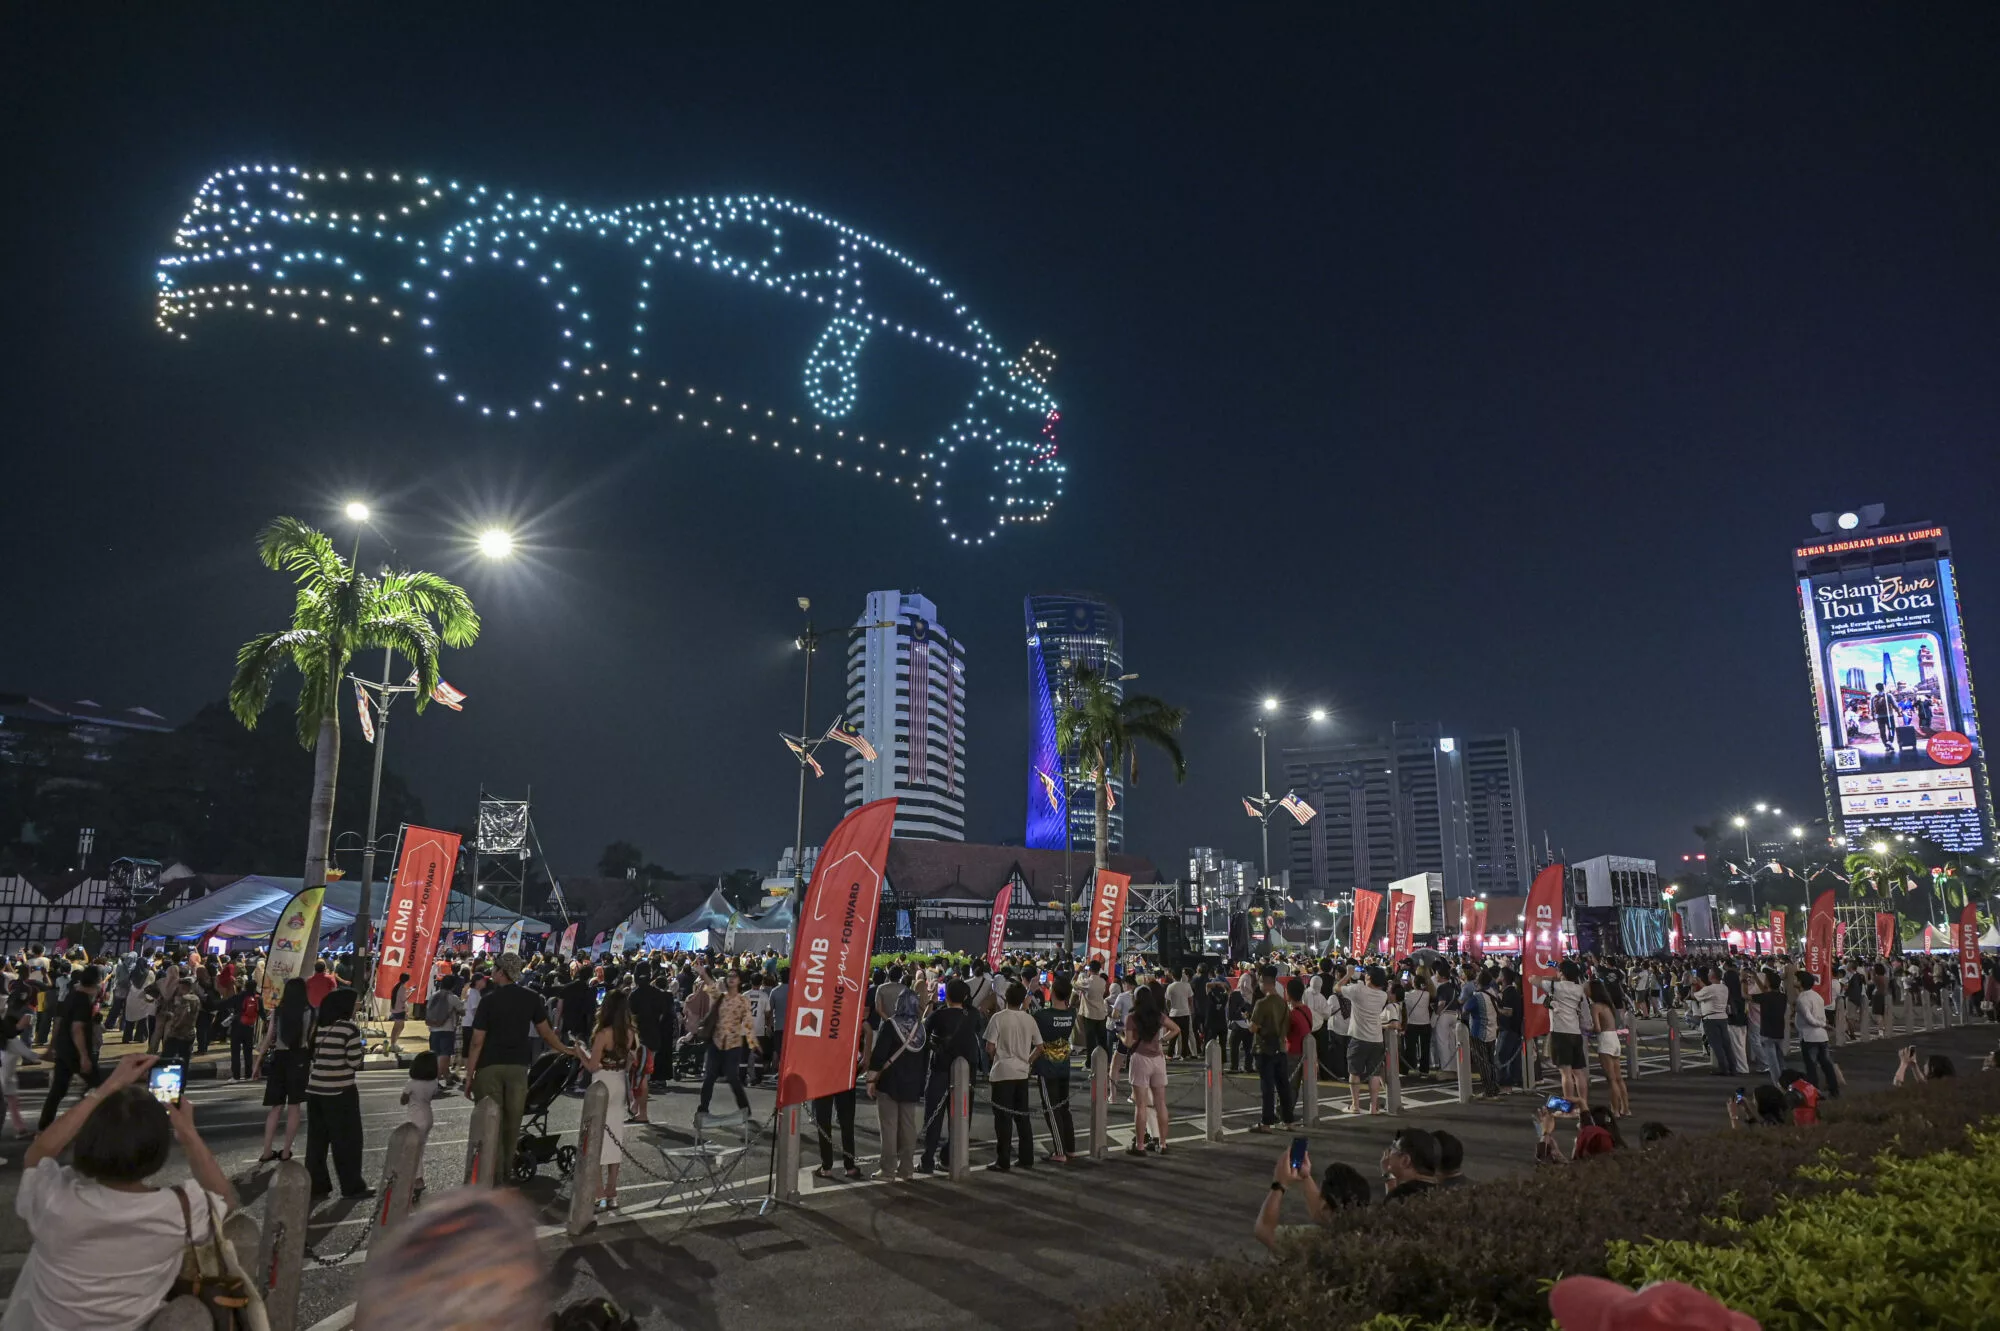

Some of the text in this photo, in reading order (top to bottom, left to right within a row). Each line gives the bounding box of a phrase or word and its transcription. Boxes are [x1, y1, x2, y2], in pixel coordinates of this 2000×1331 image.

[1797, 528, 1943, 557] DEWAN BANDARAYA KUALA LUMPUR
[1818, 576, 1935, 602] Selami Jiwa
[1821, 593, 1935, 620] Ibu Kota
[391, 898, 414, 943] CIMB
[407, 862, 437, 969] MOVING you FORWARD
[1095, 883, 1119, 943] CIMB
[1774, 916, 1784, 945] CIMB
[990, 914, 1004, 957] astro
[1396, 921, 1406, 952] astro
[1535, 904, 1552, 970] CIMB
[803, 937, 830, 1002] CIMB
[828, 882, 861, 1040] MOVING you FORWARD
[1812, 945, 1820, 973] CIMB
